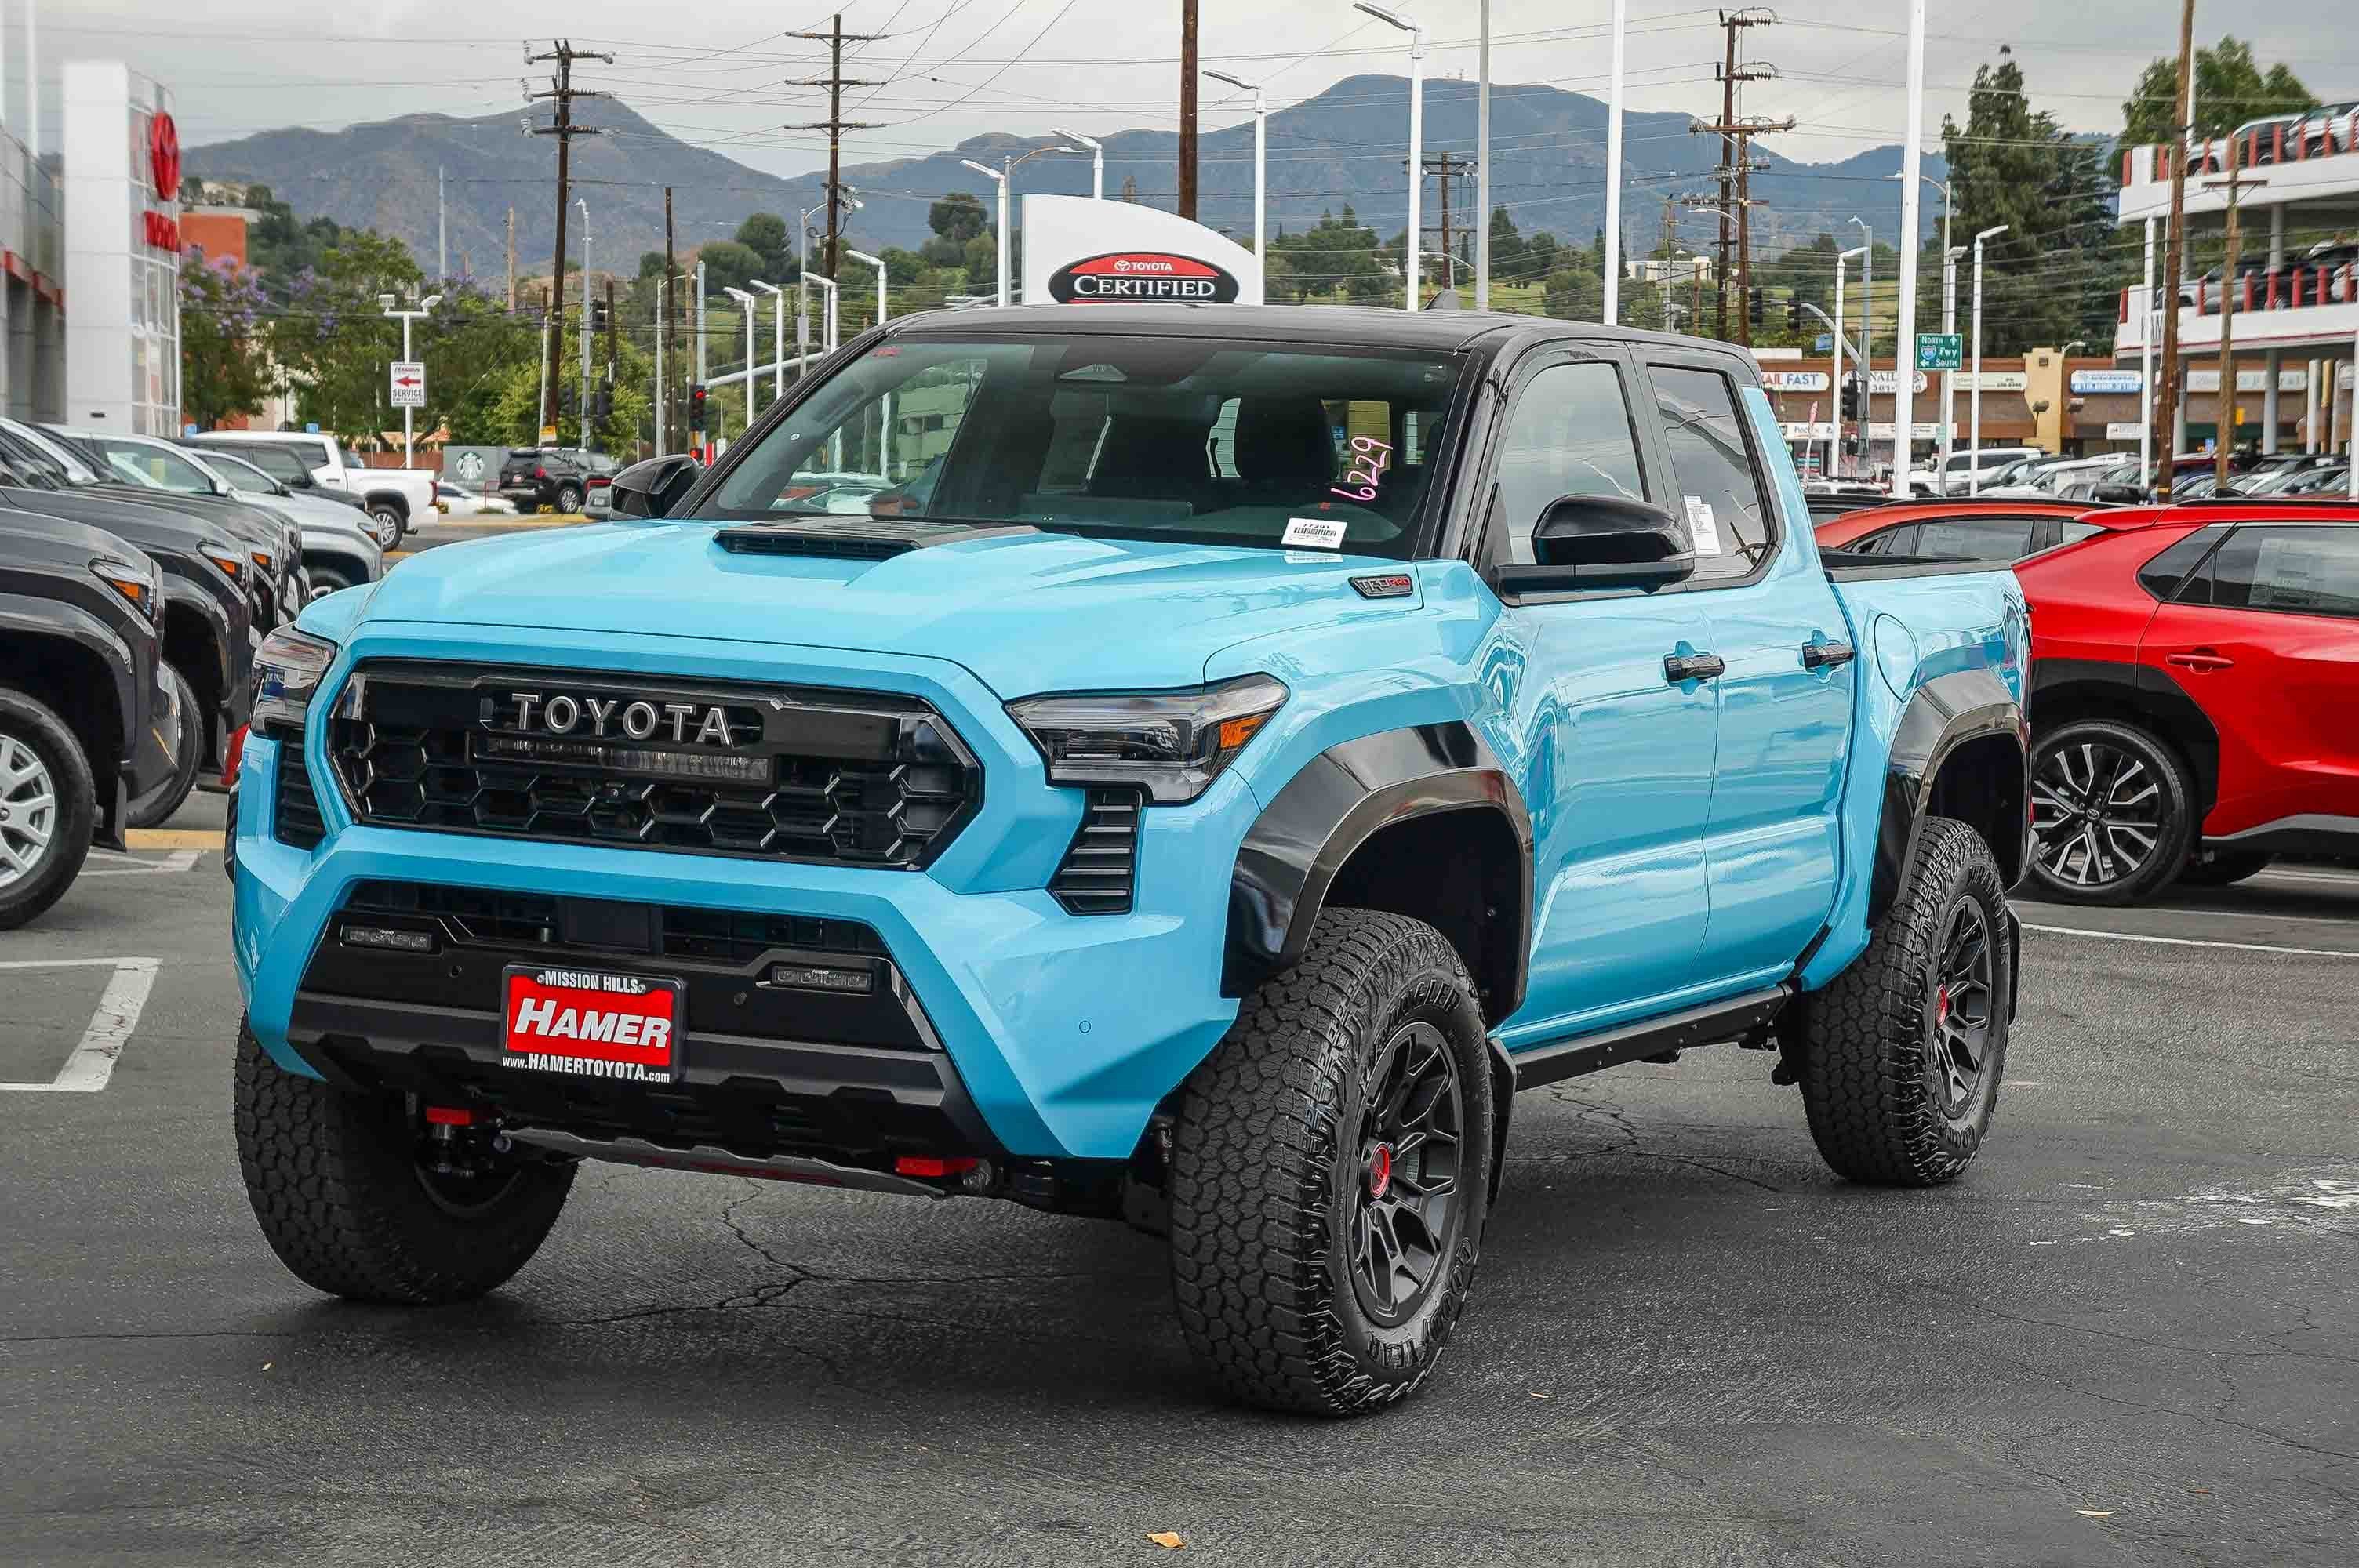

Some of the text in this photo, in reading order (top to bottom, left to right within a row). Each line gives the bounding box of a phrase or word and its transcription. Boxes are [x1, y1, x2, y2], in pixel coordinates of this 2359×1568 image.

[1132, 262, 1173, 271] TOYOTA
[1074, 275, 1216, 296] CERTIFIED
[1939, 347, 1957, 358] Fwy
[1787, 373, 1819, 385] FAST
[392, 388, 423, 397] SERVICE
[1330, 437, 1394, 501] 6229
[1356, 576, 1411, 592] TRD PRO
[511, 691, 734, 748] TOYOTA
[544, 970, 638, 994] MISSION HILLS
[514, 997, 671, 1048] HAMER
[502, 1053, 670, 1083] www.HAMERTOYOTA.com
